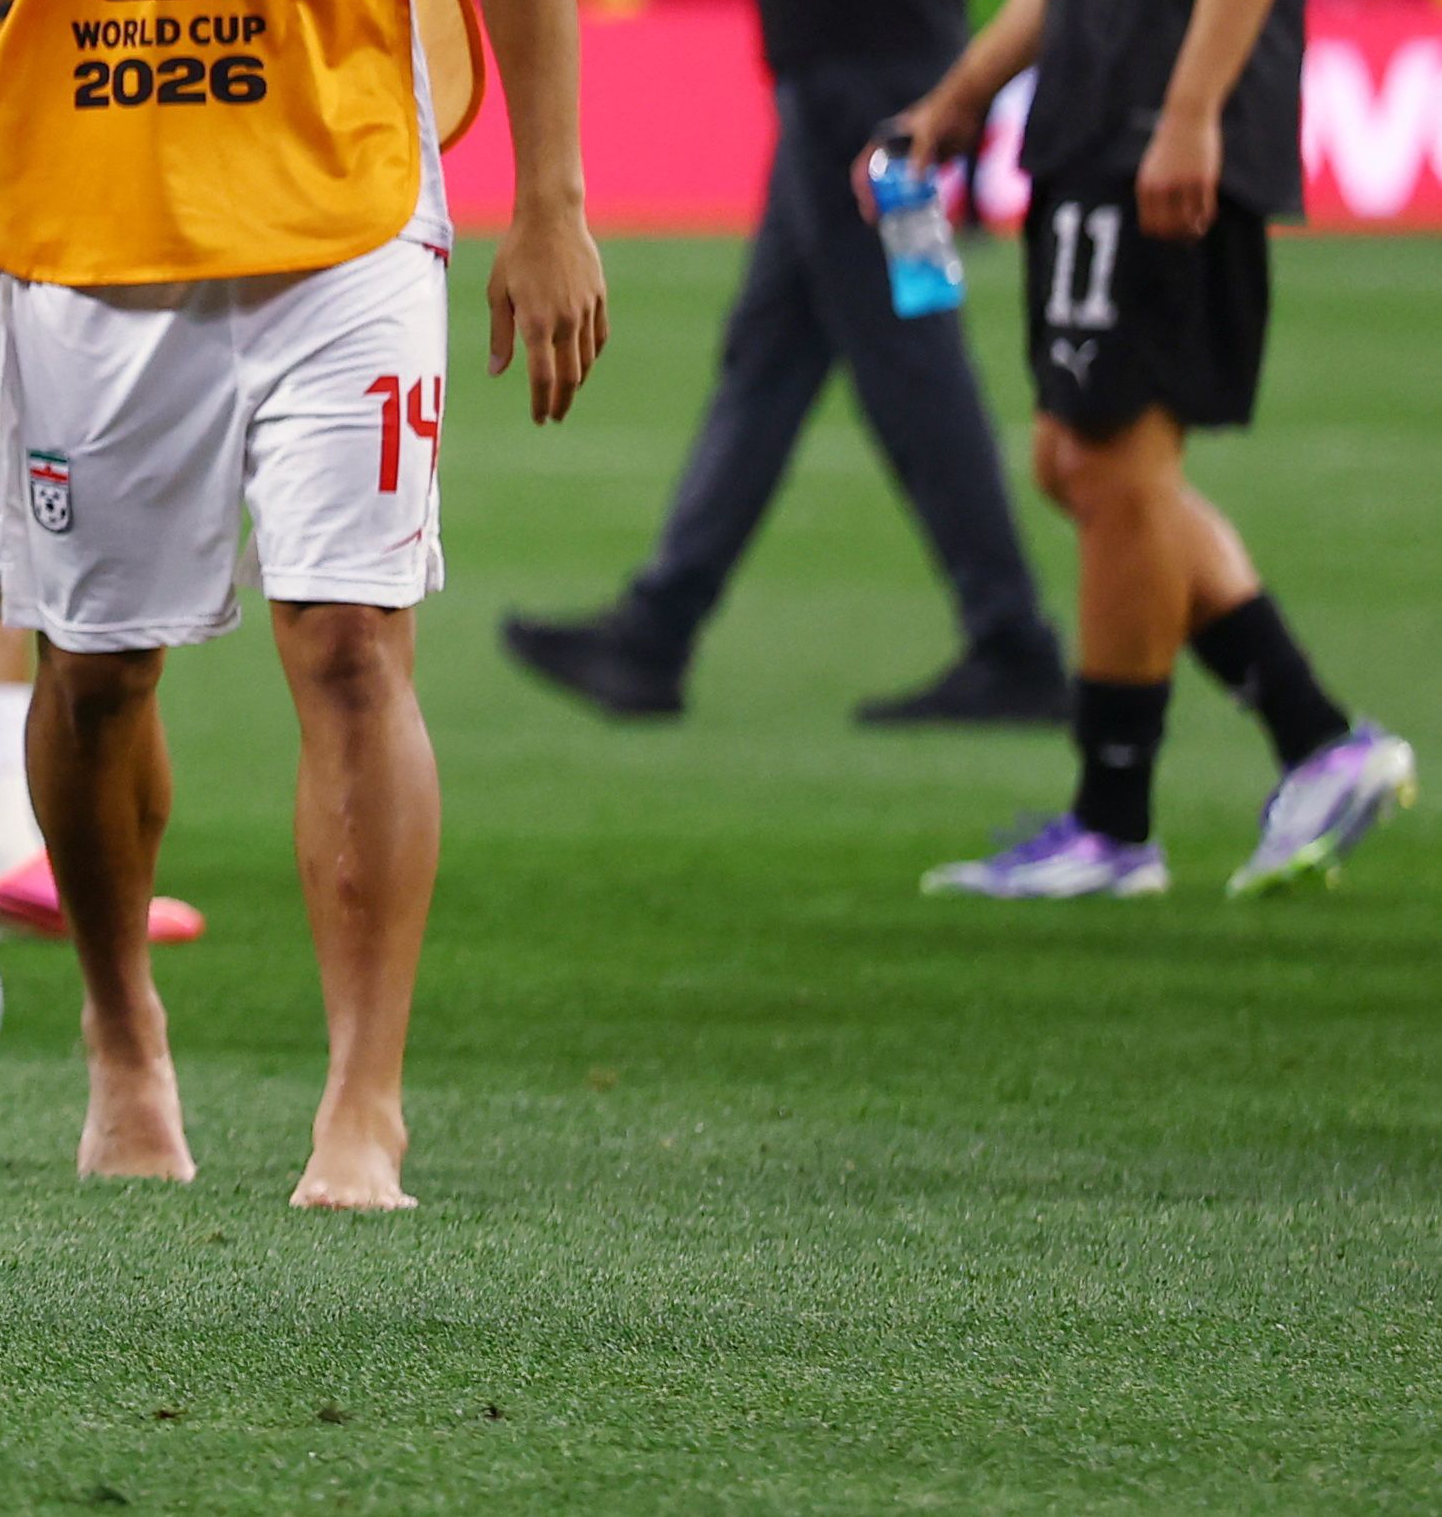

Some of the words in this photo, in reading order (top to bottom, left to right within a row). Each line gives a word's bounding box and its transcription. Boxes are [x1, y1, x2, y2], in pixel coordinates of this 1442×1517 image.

[71, 16, 181, 49] WORLD
[188, 15, 267, 46] CUP
[74, 55, 267, 109] 2026
[1046, 201, 1121, 328] 11
[362, 375, 442, 497] 14
